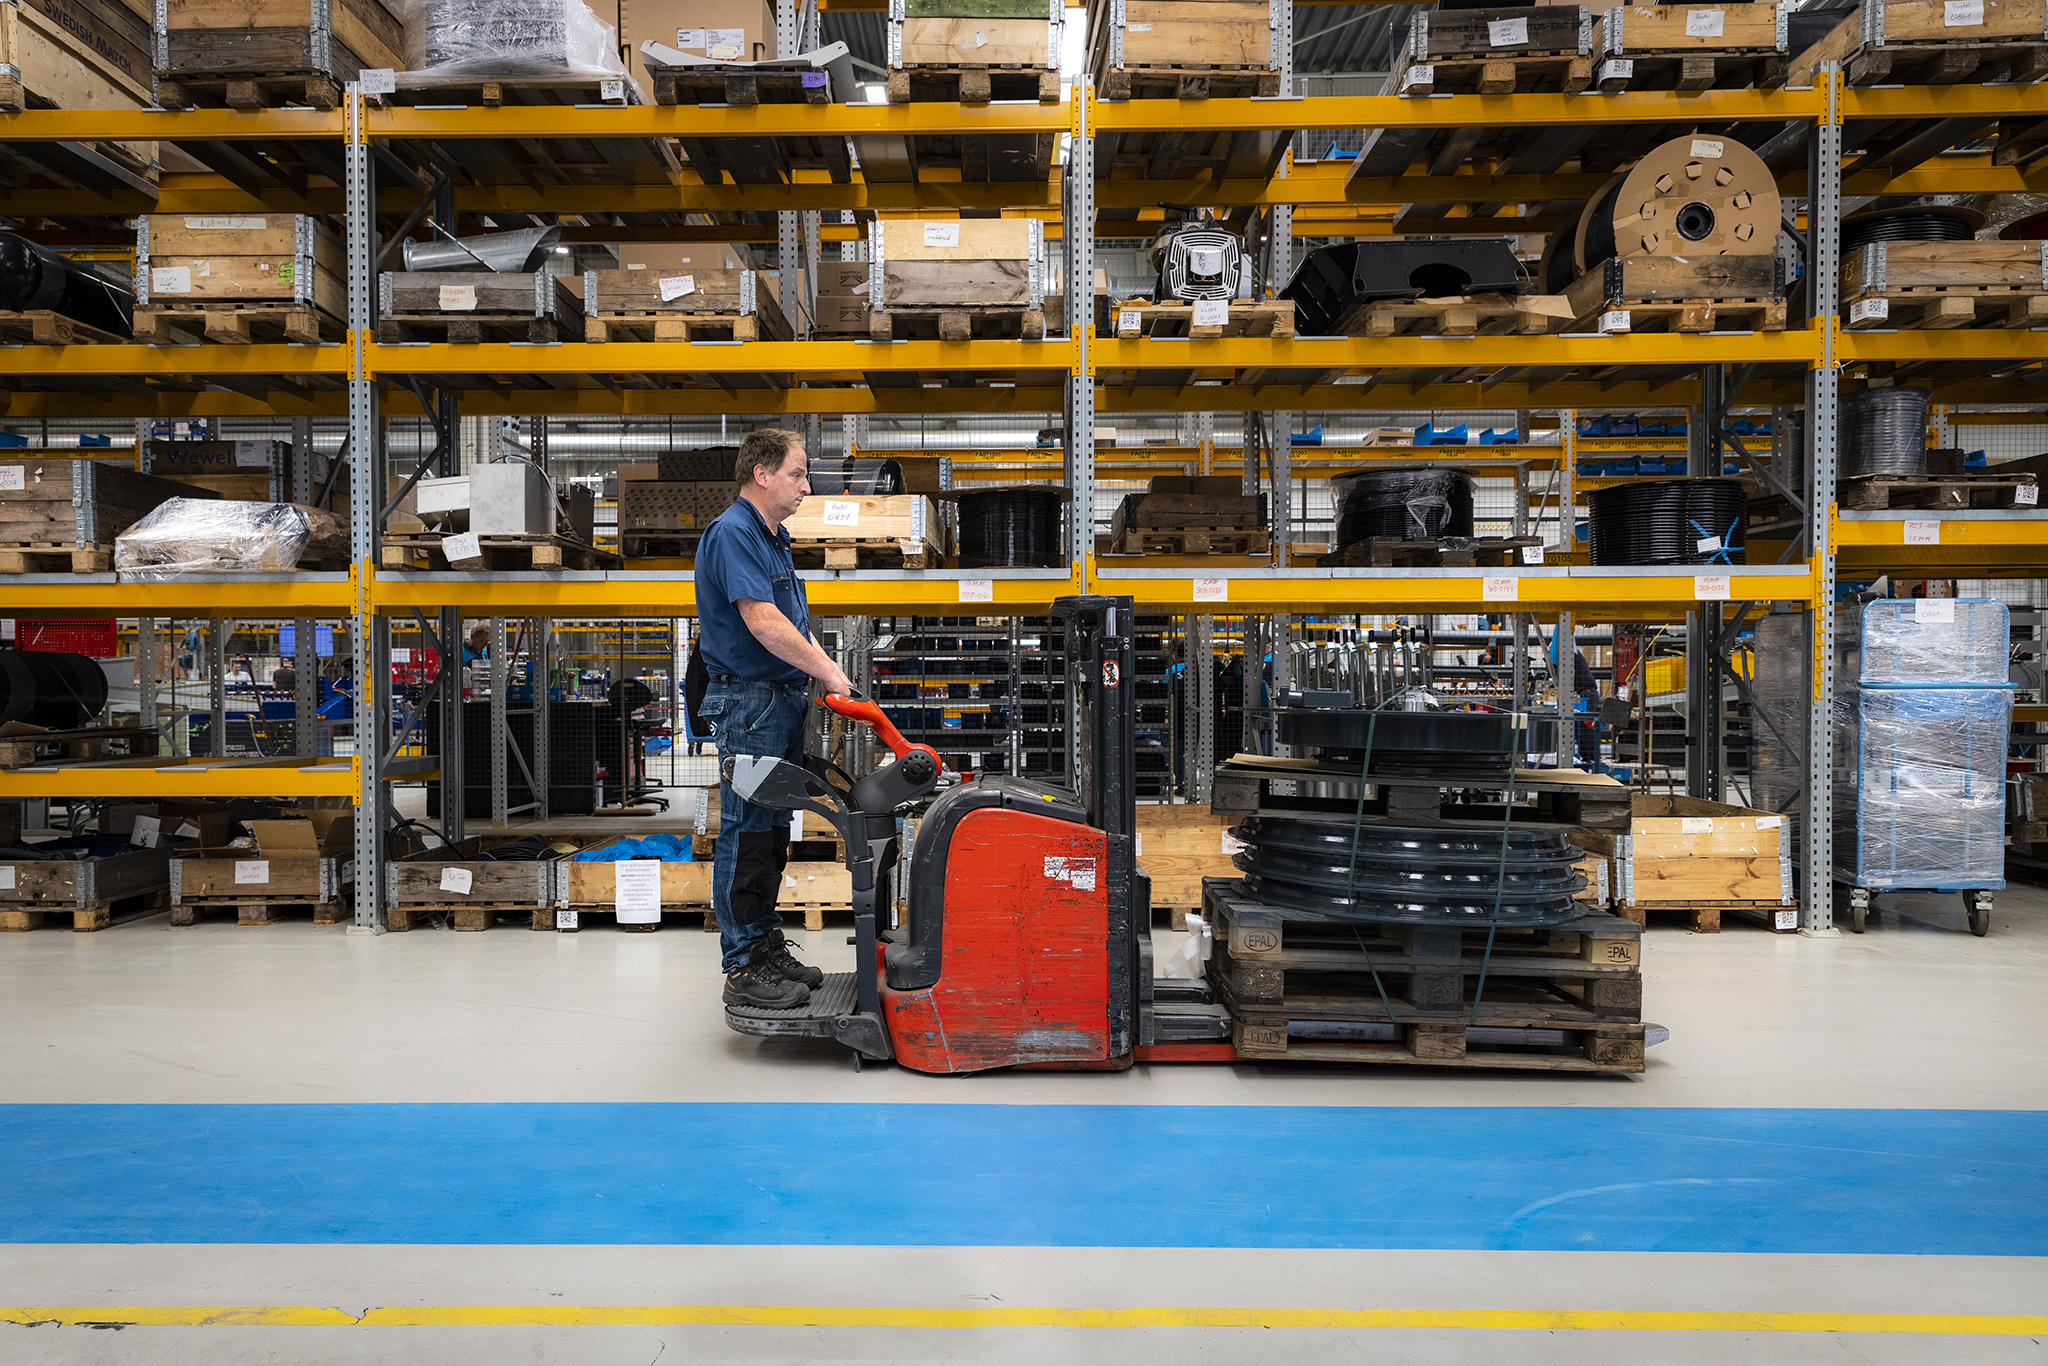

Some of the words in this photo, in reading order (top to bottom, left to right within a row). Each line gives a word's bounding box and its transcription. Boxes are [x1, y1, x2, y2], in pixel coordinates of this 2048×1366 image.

[44, 0, 93, 46] SWEDISH
[95, 35, 132, 74] MATCH
[166, 449, 237, 465] Wewel
[1249, 935, 1273, 949] EPAL
[1607, 946, 1632, 959] EPAL
[1250, 1032, 1276, 1044] EPAL
